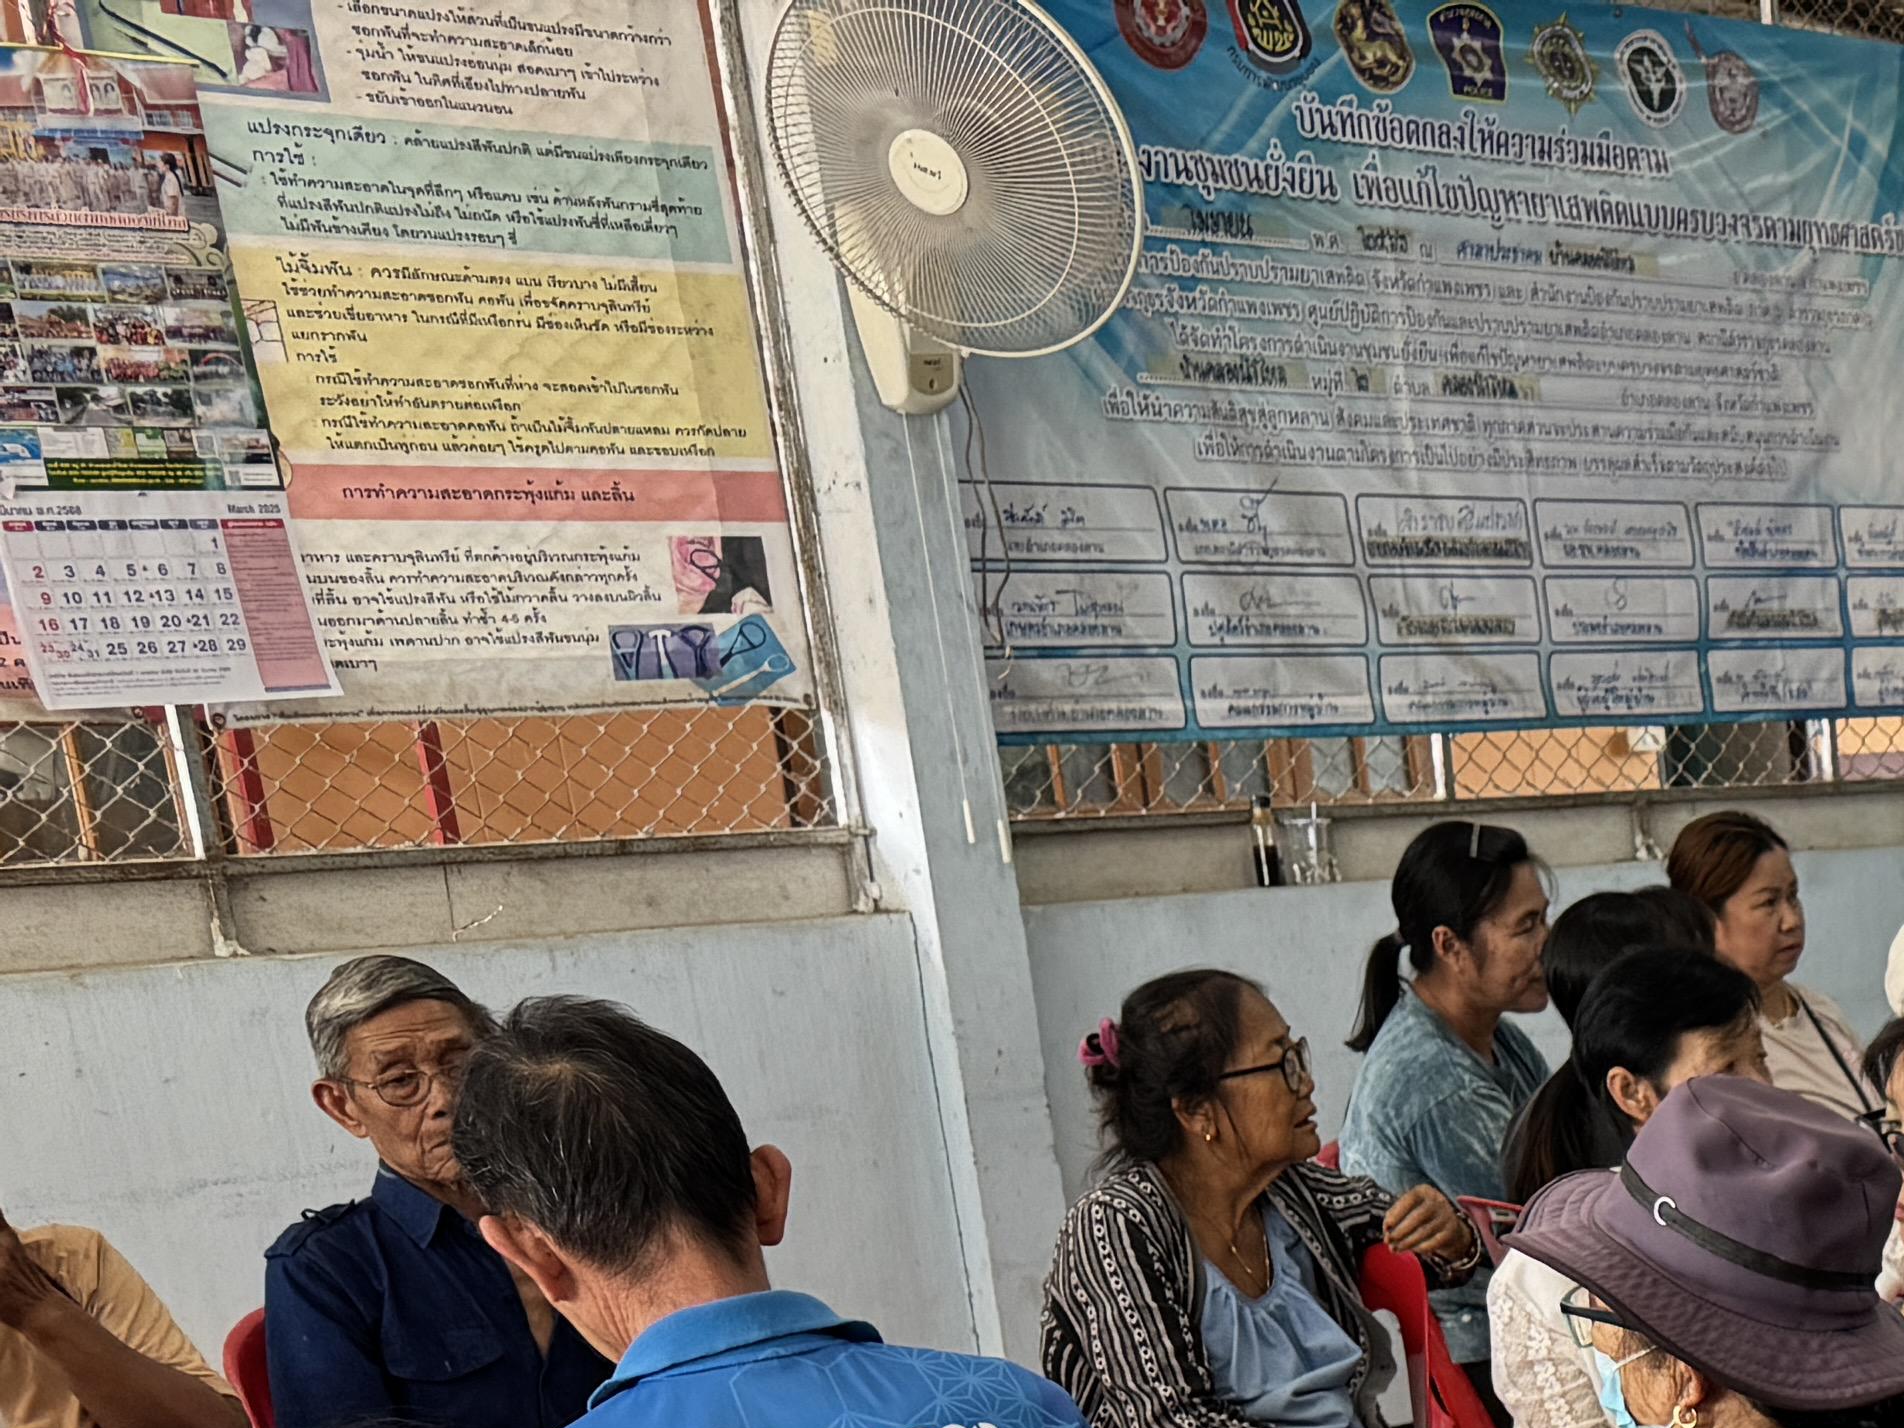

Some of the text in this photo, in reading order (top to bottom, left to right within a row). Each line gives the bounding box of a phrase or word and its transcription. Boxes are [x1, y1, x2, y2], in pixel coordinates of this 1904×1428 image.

[211, 538, 218, 549] 1
[32, 563, 227, 579] 2 3 4 5 6 7 8
[41, 588, 233, 605] 9 10 11 12 13 14 15
[39, 613, 240, 632] 16 17 18 19 20 21 22
[106, 643, 128, 656] 25
[137, 642, 158, 654] 26
[167, 641, 187, 653] 27
[197, 640, 218, 652] 28
[227, 639, 246, 651] 29
